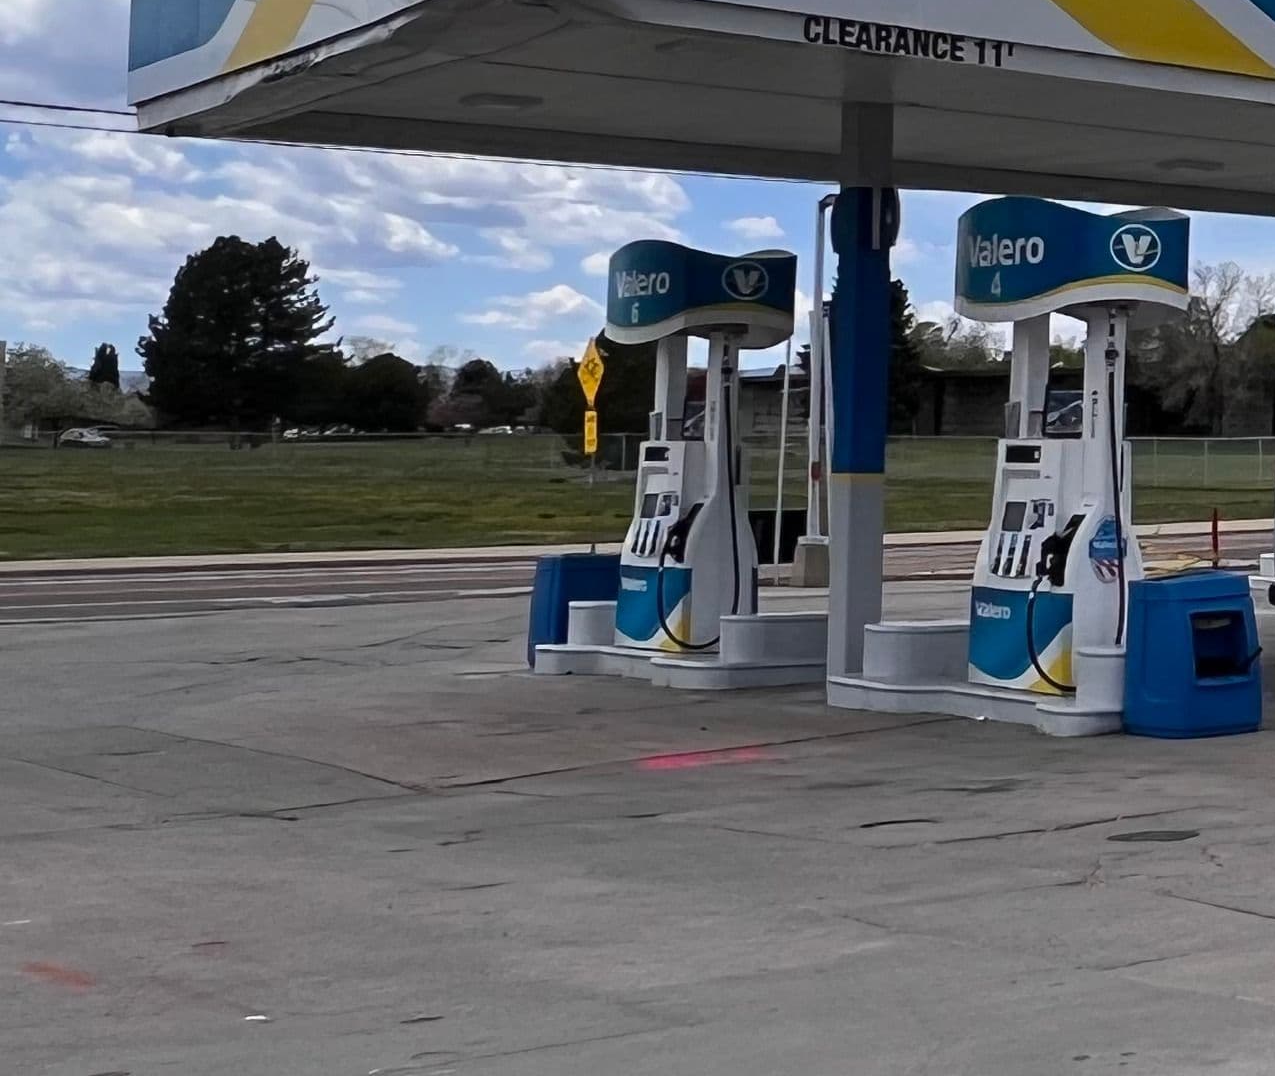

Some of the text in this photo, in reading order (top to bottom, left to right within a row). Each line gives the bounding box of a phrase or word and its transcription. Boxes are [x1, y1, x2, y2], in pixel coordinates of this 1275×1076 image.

[803, 15, 965, 63] CLEARANCE
[968, 233, 1045, 268] Valero
[616, 269, 670, 299] Valero
